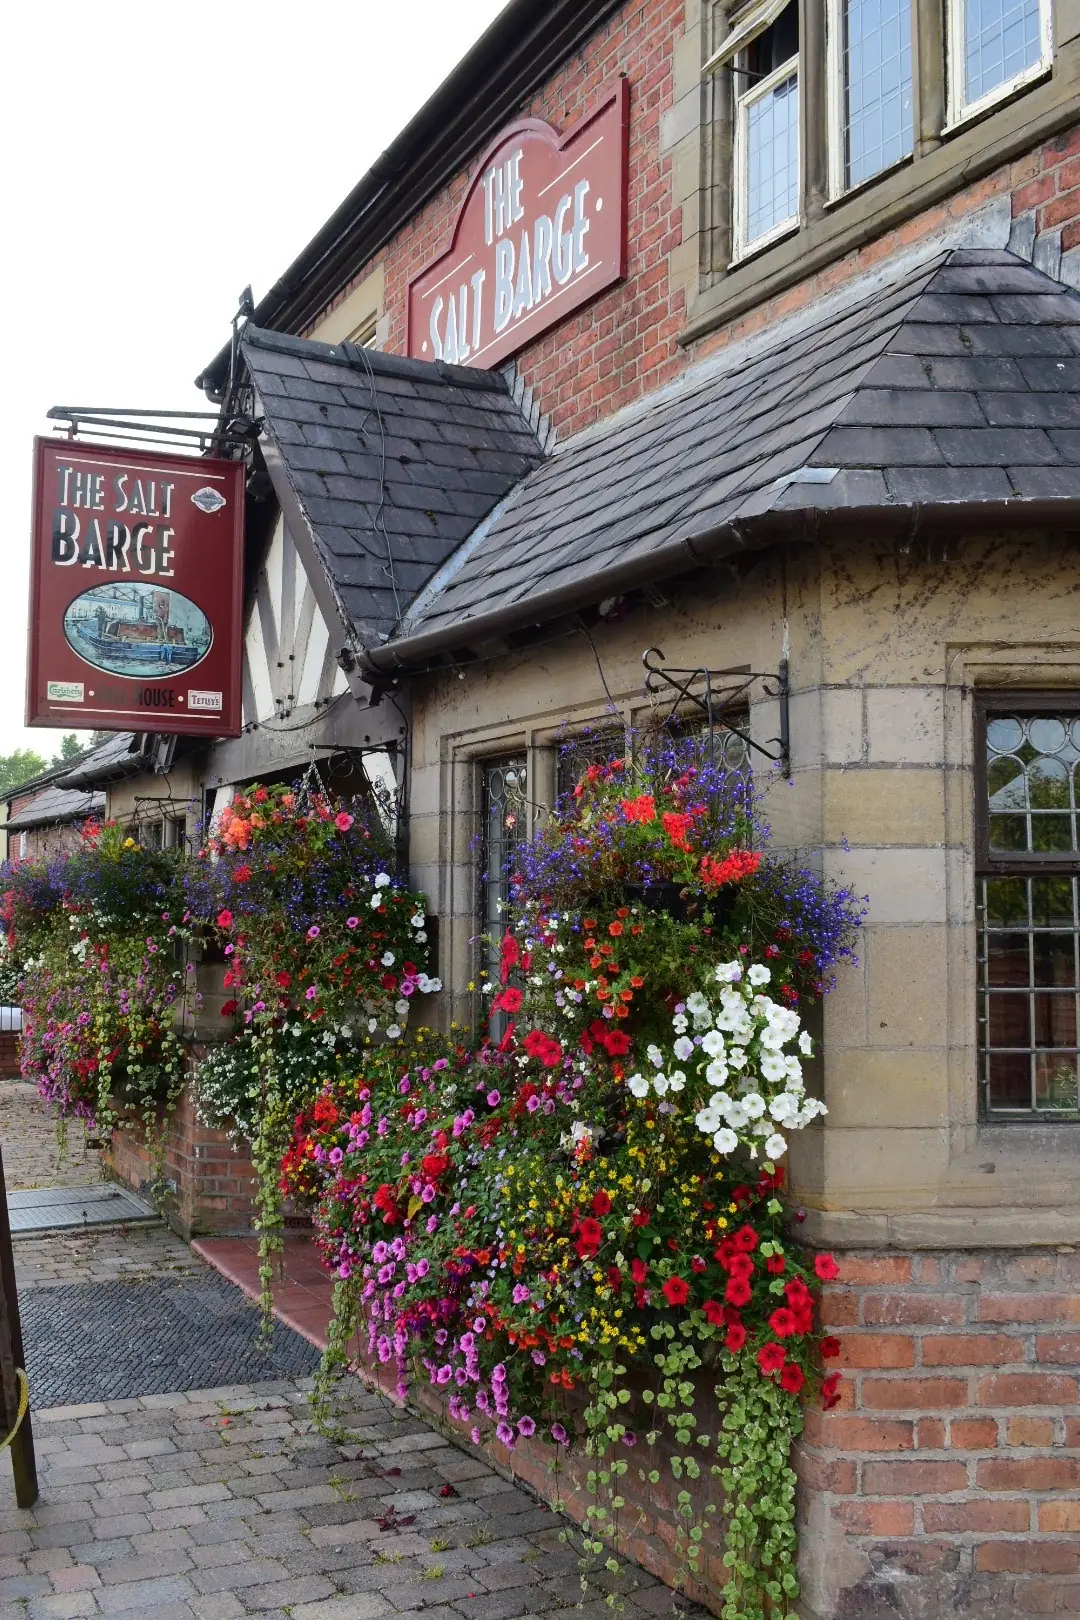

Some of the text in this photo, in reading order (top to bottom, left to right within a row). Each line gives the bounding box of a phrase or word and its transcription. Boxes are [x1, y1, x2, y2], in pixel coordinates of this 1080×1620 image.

[481, 149, 524, 246] THE
[430, 178, 590, 365] SALT BARGE
[58, 464, 175, 518] THE SALT
[52, 510, 175, 577] BARGE
[49, 684, 82, 698] Carlsberg
